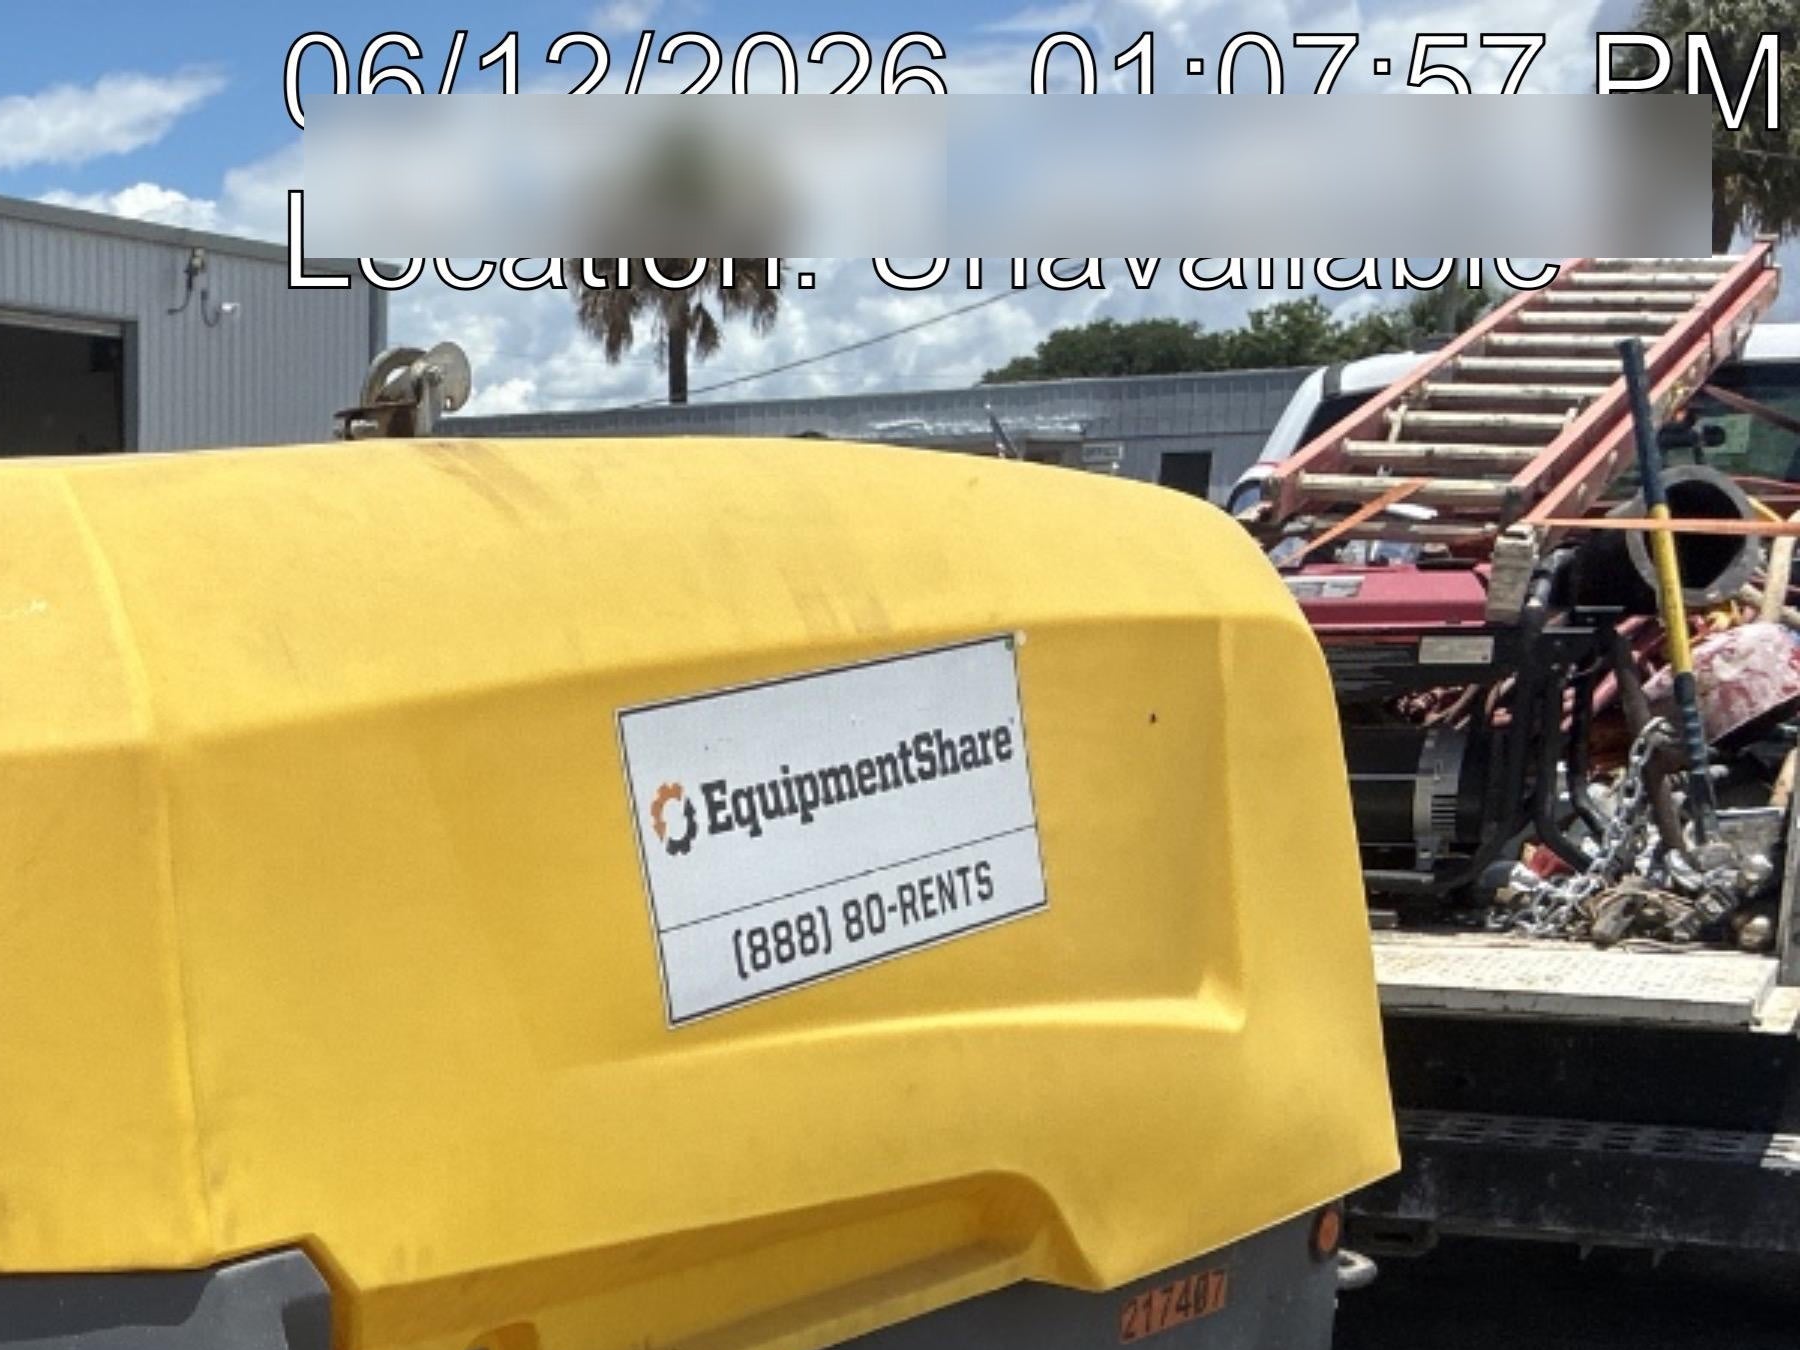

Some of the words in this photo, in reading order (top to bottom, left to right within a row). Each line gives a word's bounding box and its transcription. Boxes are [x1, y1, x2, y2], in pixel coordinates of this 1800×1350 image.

[699, 722, 1015, 837] EquipmentShare
[731, 905, 833, 979] (888)
[841, 860, 995, 943] 80-RENTS
